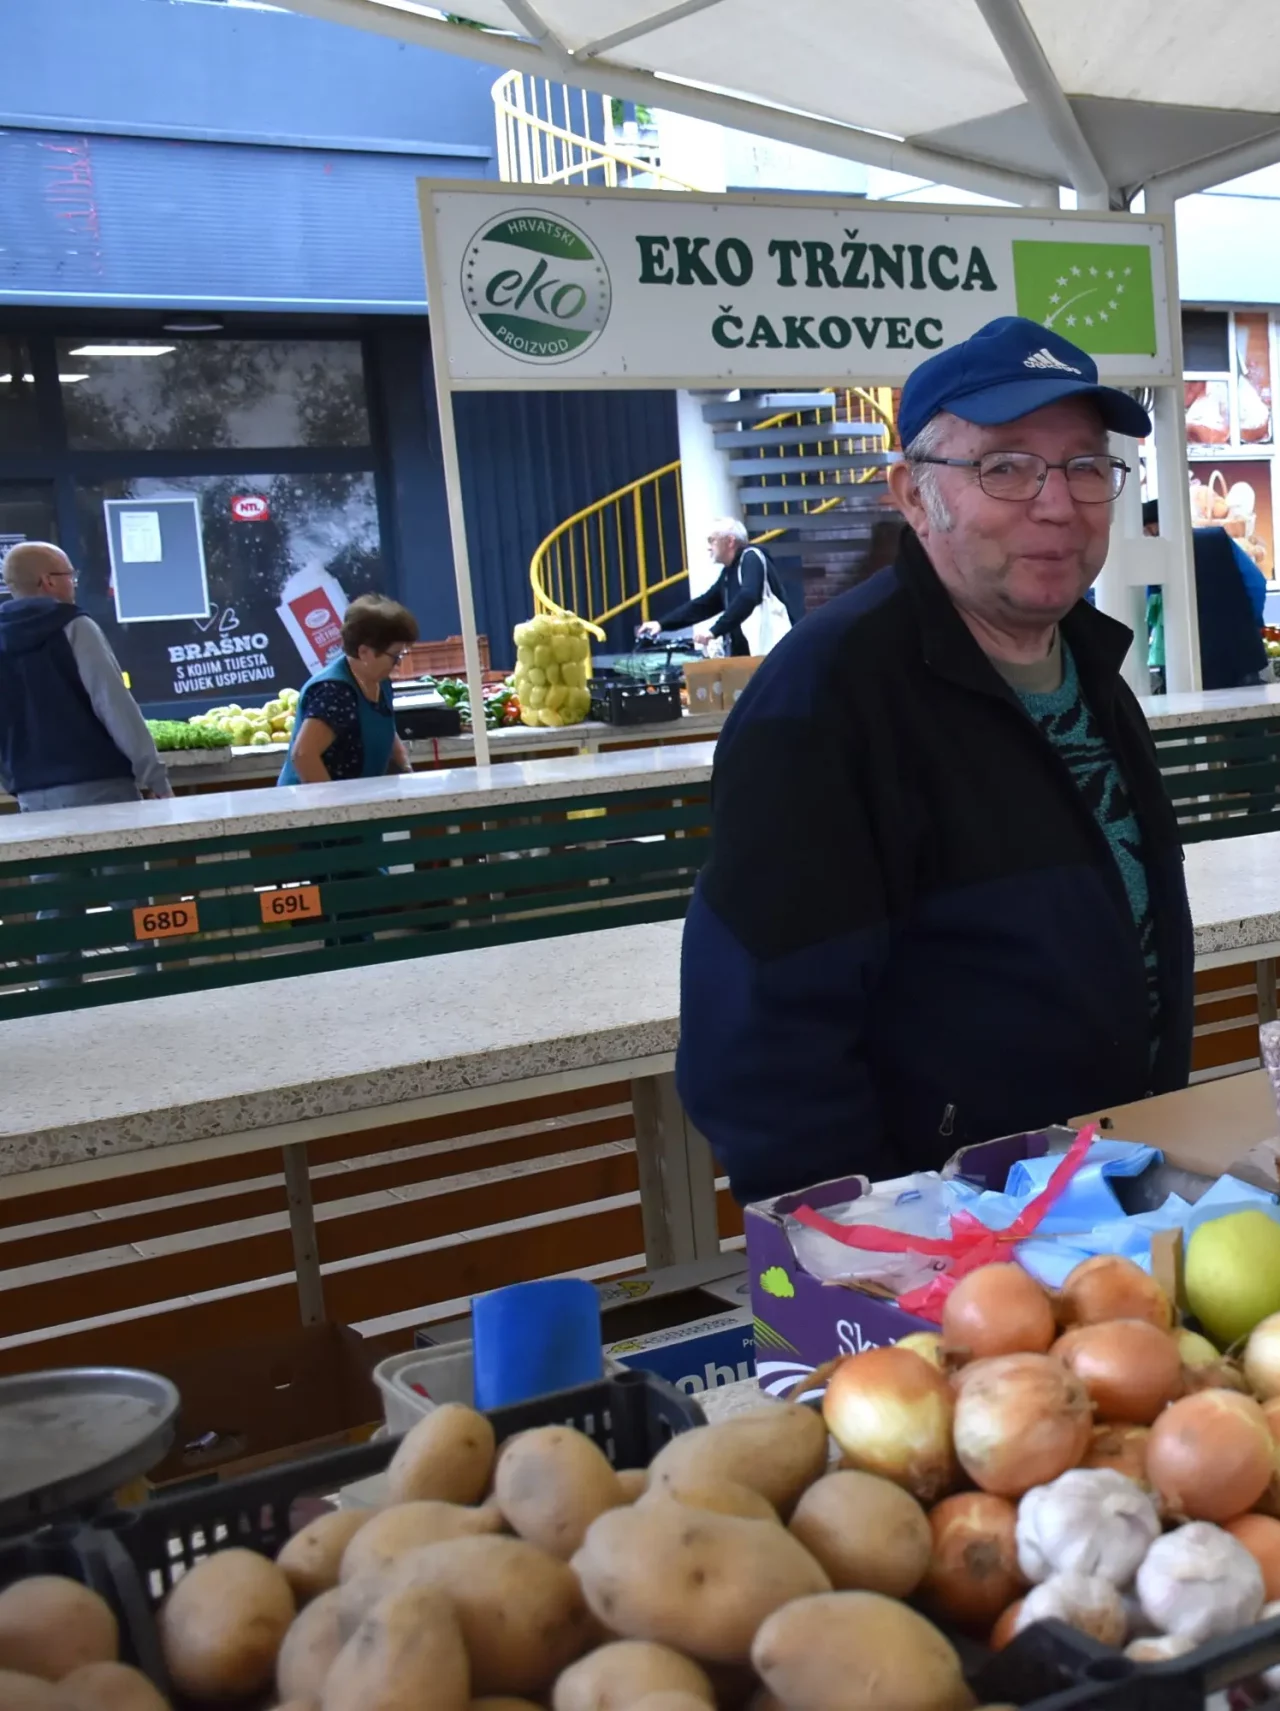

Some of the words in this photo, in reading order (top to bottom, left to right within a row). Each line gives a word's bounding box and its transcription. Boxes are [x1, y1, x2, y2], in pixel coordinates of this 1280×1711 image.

[508, 219, 576, 247] HRVATSKI
[635, 234, 754, 287] EKO
[767, 228, 998, 291] TRŽNICA
[485, 257, 587, 320] eko
[496, 325, 569, 354] PROIZVOD
[711, 304, 944, 350] ČAKOVEC
[167, 632, 269, 663] BRAŠNO
[173, 676, 215, 694] UVIJEK
[215, 665, 276, 688] USPJEVAJU
[176, 665, 185, 679] S
[187, 659, 222, 678] KOJIM
[224, 653, 268, 672] TIJESTA
[271, 893, 311, 915] 69L
[142, 909, 188, 932] 68D
